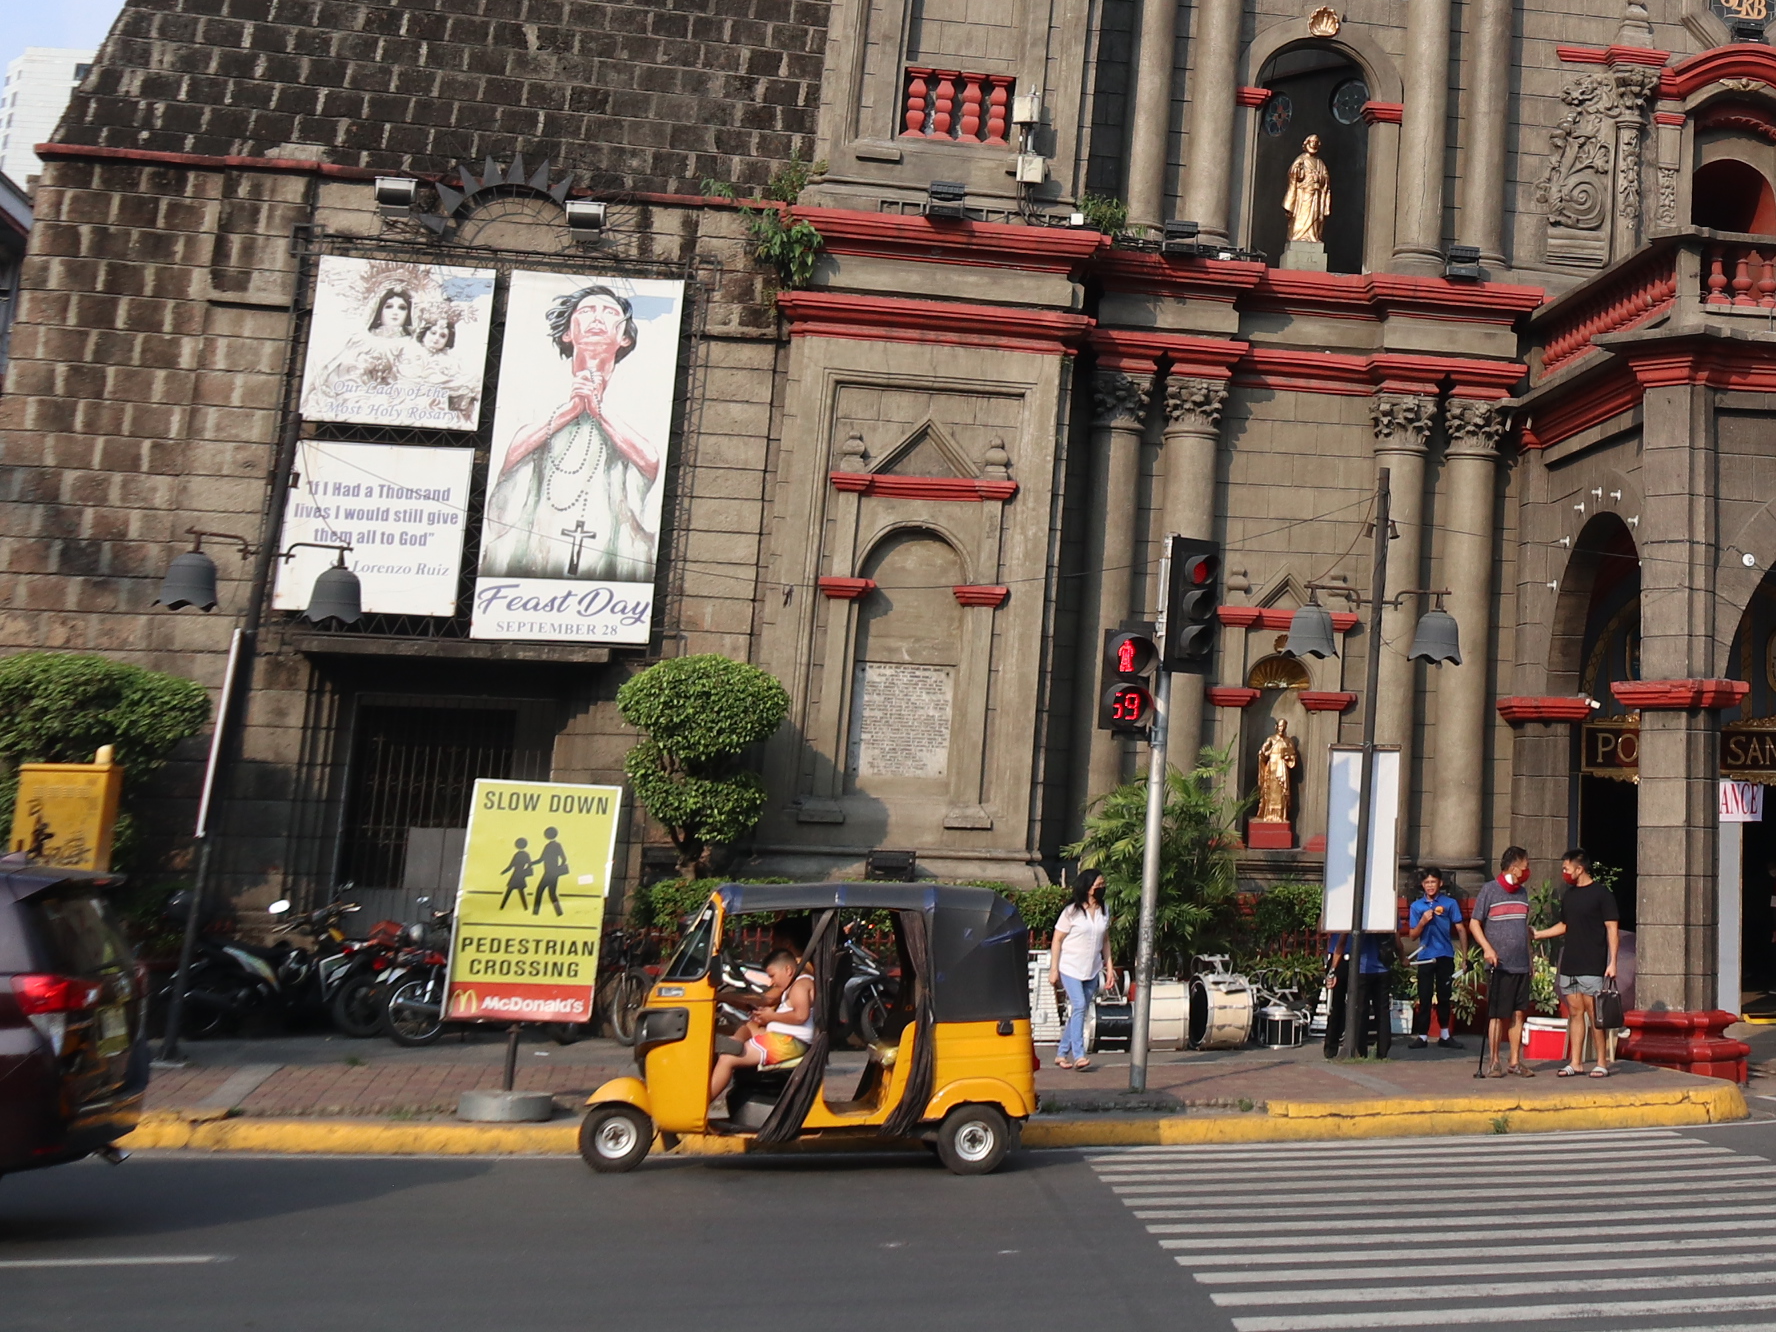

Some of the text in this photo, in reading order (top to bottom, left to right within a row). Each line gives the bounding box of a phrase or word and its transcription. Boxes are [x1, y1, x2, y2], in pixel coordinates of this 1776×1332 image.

[333, 380, 448, 401] Our Lady of the
[324, 401, 457, 424] Most Holy Rosary
[322, 481, 328, 496] I
[332, 482, 361, 498] Had
[364, 487, 373, 498] a
[378, 484, 451, 502] Thousand
[294, 503, 459, 526] lives I would still give
[313, 528, 352, 544] them
[356, 530, 376, 544] all
[380, 532, 394, 545] to
[352, 559, 412, 576] Lorenzo
[415, 563, 450, 577] Ruiz
[477, 583, 651, 626] Feast Day
[496, 621, 618, 636] SEPTEMBER 28
[1596, 732, 1639, 763] PO
[483, 791, 609, 815] SLOW DOWN
[1719, 783, 1760, 815] ANCE
[460, 937, 596, 956] PEDESTRIAN
[469, 958, 580, 978] CROSSING
[480, 995, 585, 1014] McDonald's
